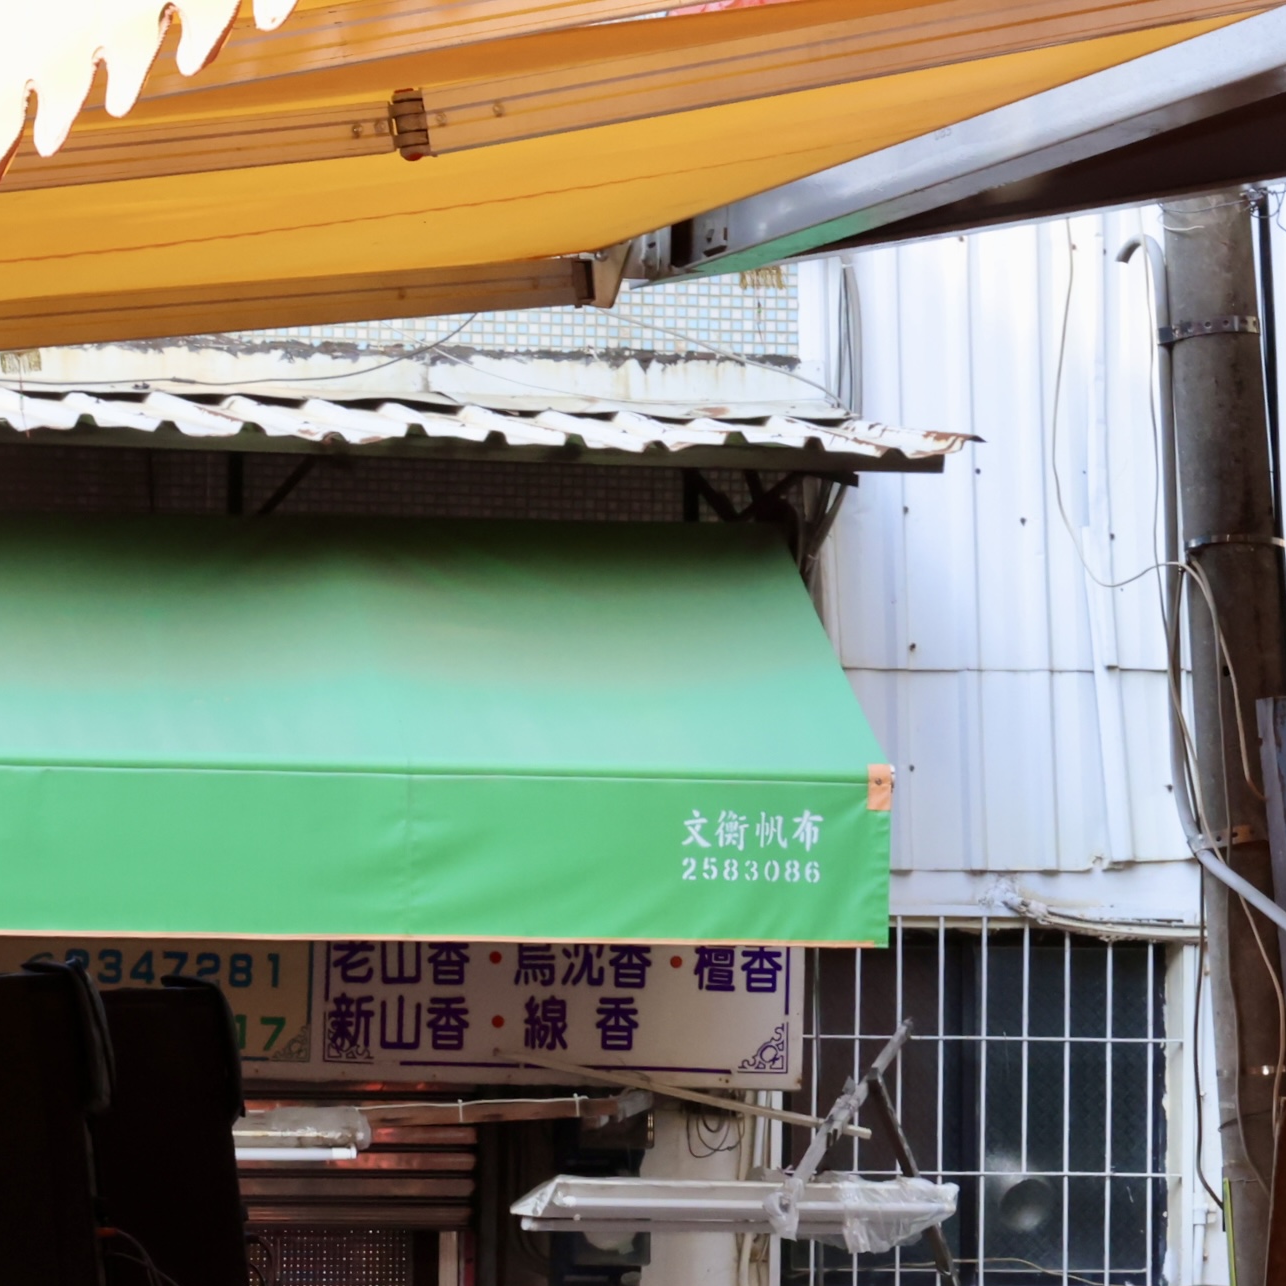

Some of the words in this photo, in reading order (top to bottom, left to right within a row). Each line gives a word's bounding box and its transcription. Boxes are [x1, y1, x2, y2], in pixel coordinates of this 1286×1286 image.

[681, 809, 824, 852] 文衡帆布
[681, 857, 821, 883] 2583086
[329, 992, 470, 1051] 新山香
